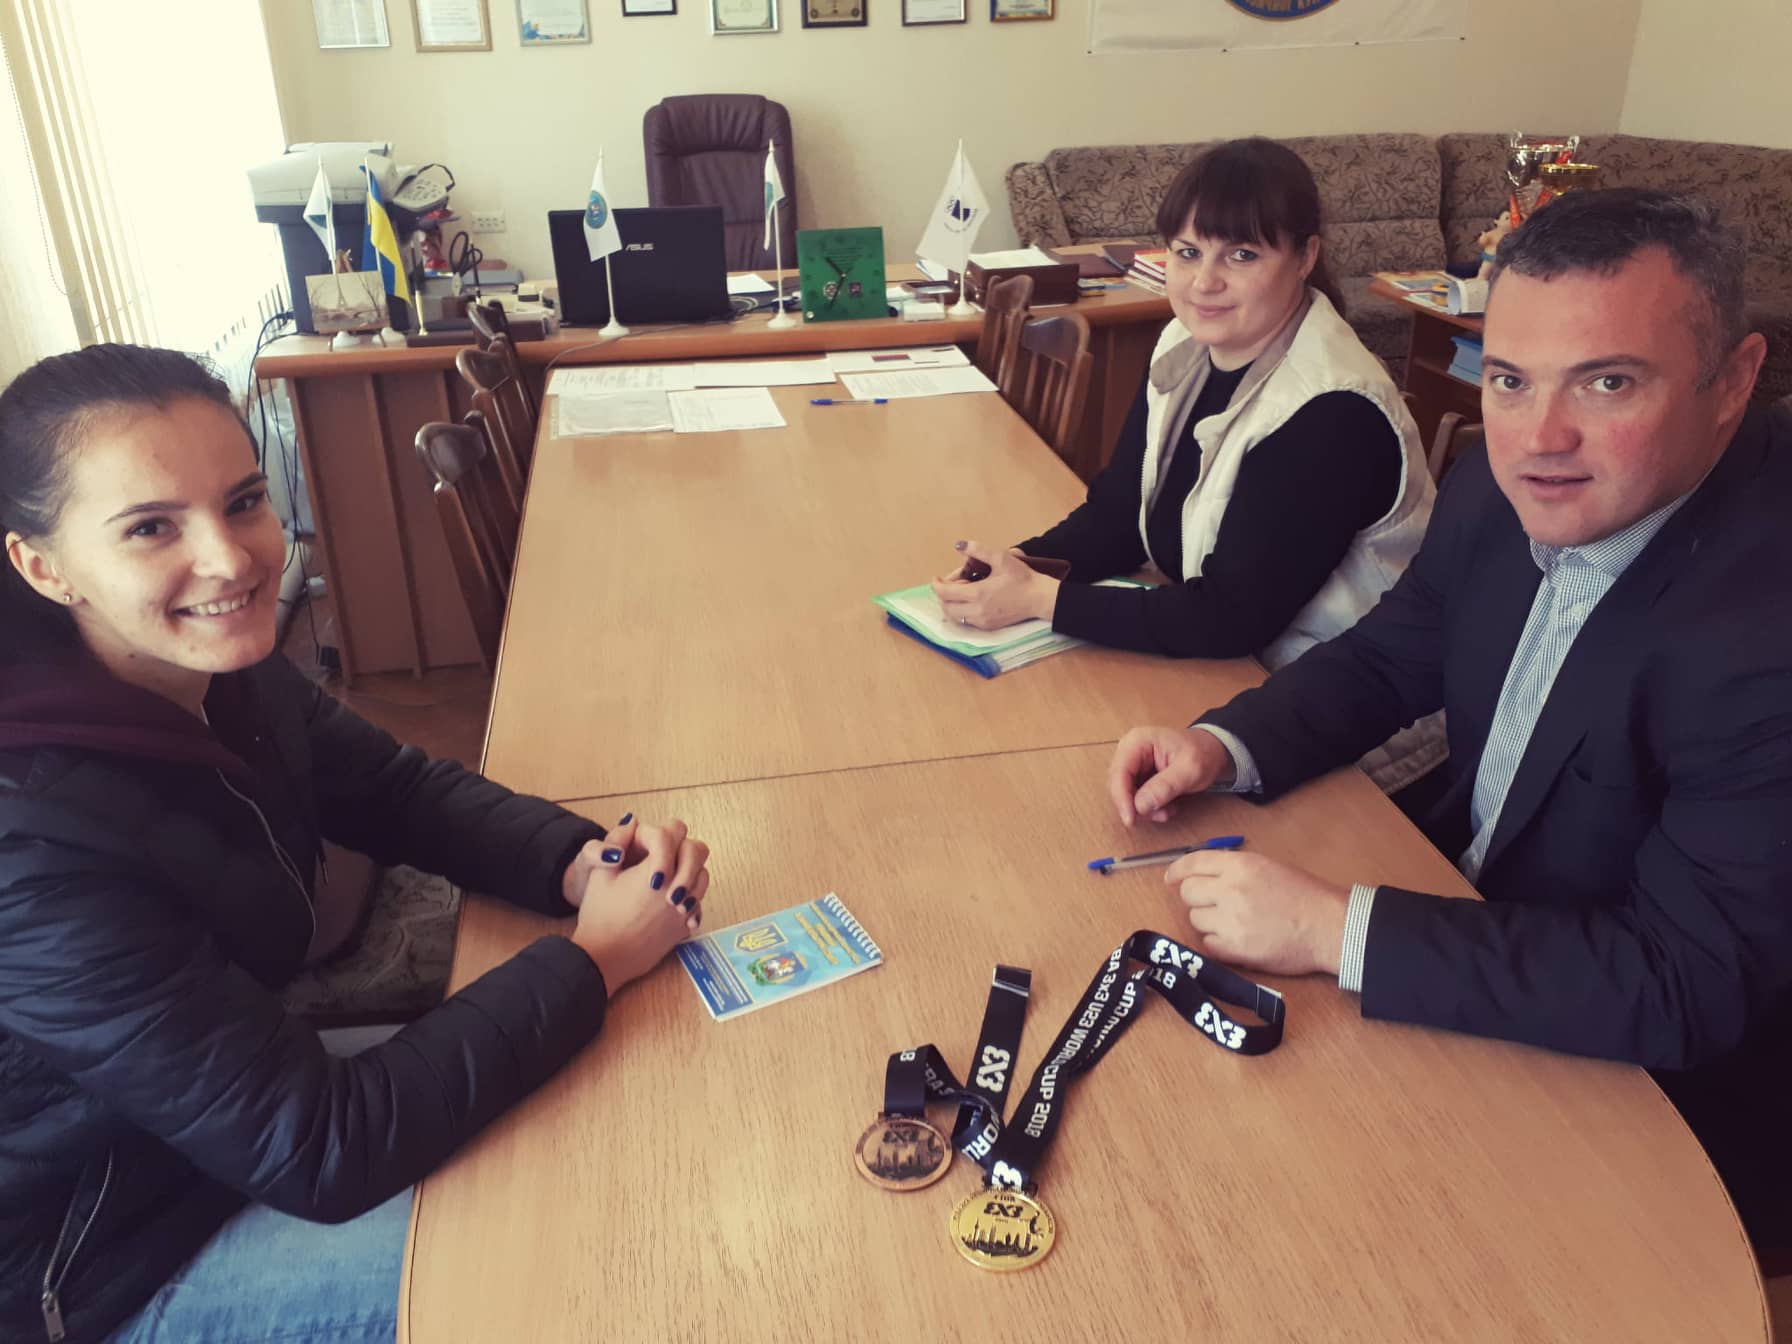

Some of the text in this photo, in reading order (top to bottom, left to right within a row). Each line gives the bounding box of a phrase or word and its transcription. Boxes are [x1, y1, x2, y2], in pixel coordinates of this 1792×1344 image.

[626, 243, 654, 251] ASUS
[1078, 1003, 1105, 1029] U23
[1114, 981, 1137, 1017] CUP
[1039, 1065, 1059, 1101] CUP
[1024, 1102, 1052, 1139] 2018
